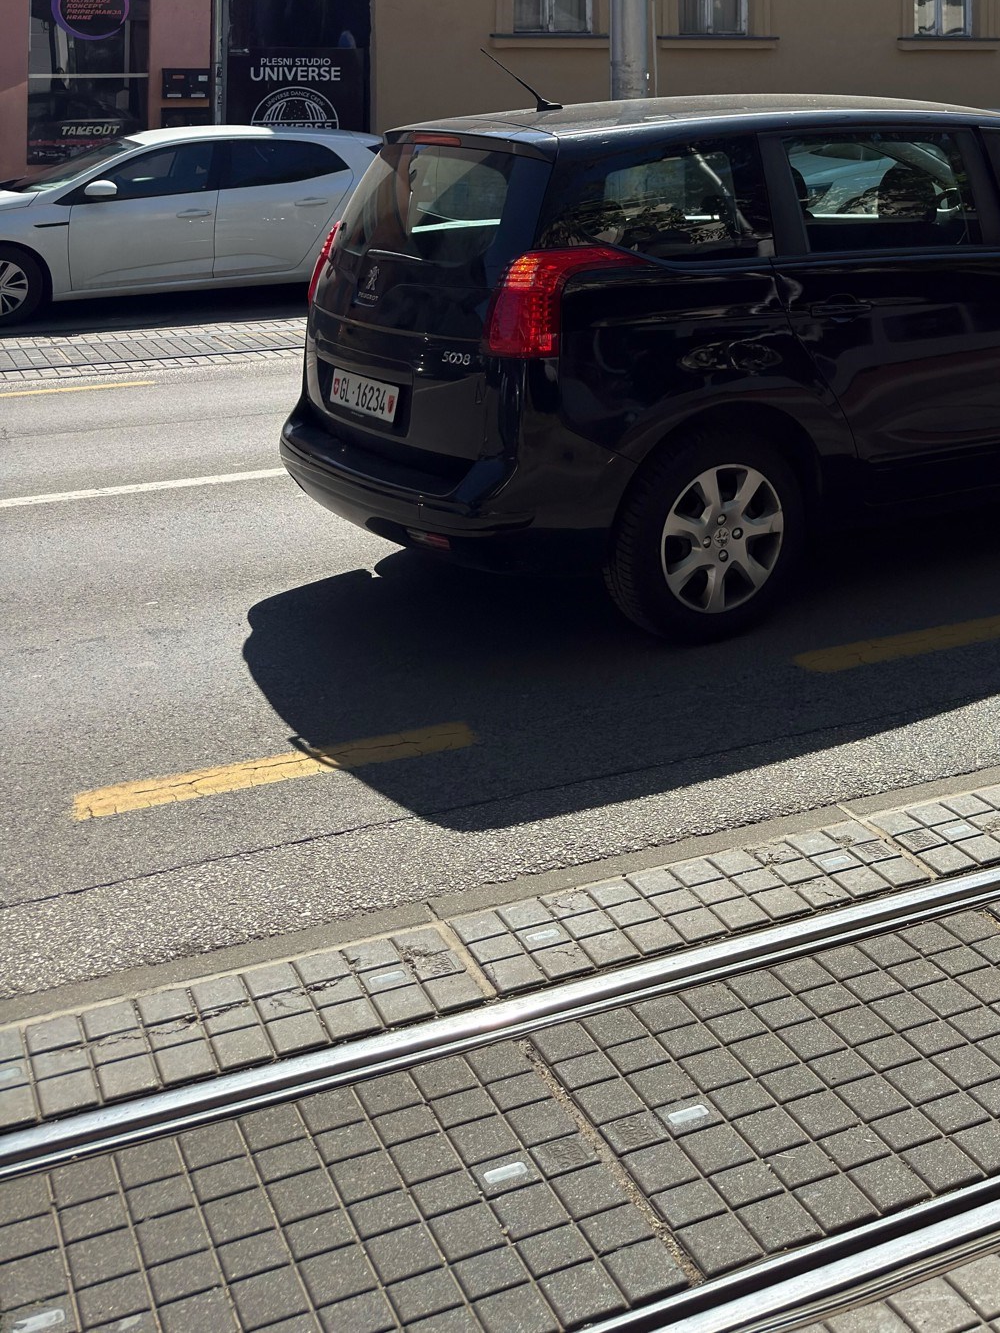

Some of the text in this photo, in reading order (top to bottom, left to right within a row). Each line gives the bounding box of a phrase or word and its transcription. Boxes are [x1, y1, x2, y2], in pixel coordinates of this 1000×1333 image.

[260, 57, 331, 66] PLESNI STUDIO
[250, 66, 341, 82] UNIVERSE
[265, 90, 326, 107] UNIVERSE DANCE CREW
[61, 124, 120, 136] TAKEOUT
[358, 292, 380, 302] PEUGEOT
[441, 350, 471, 366] 5008
